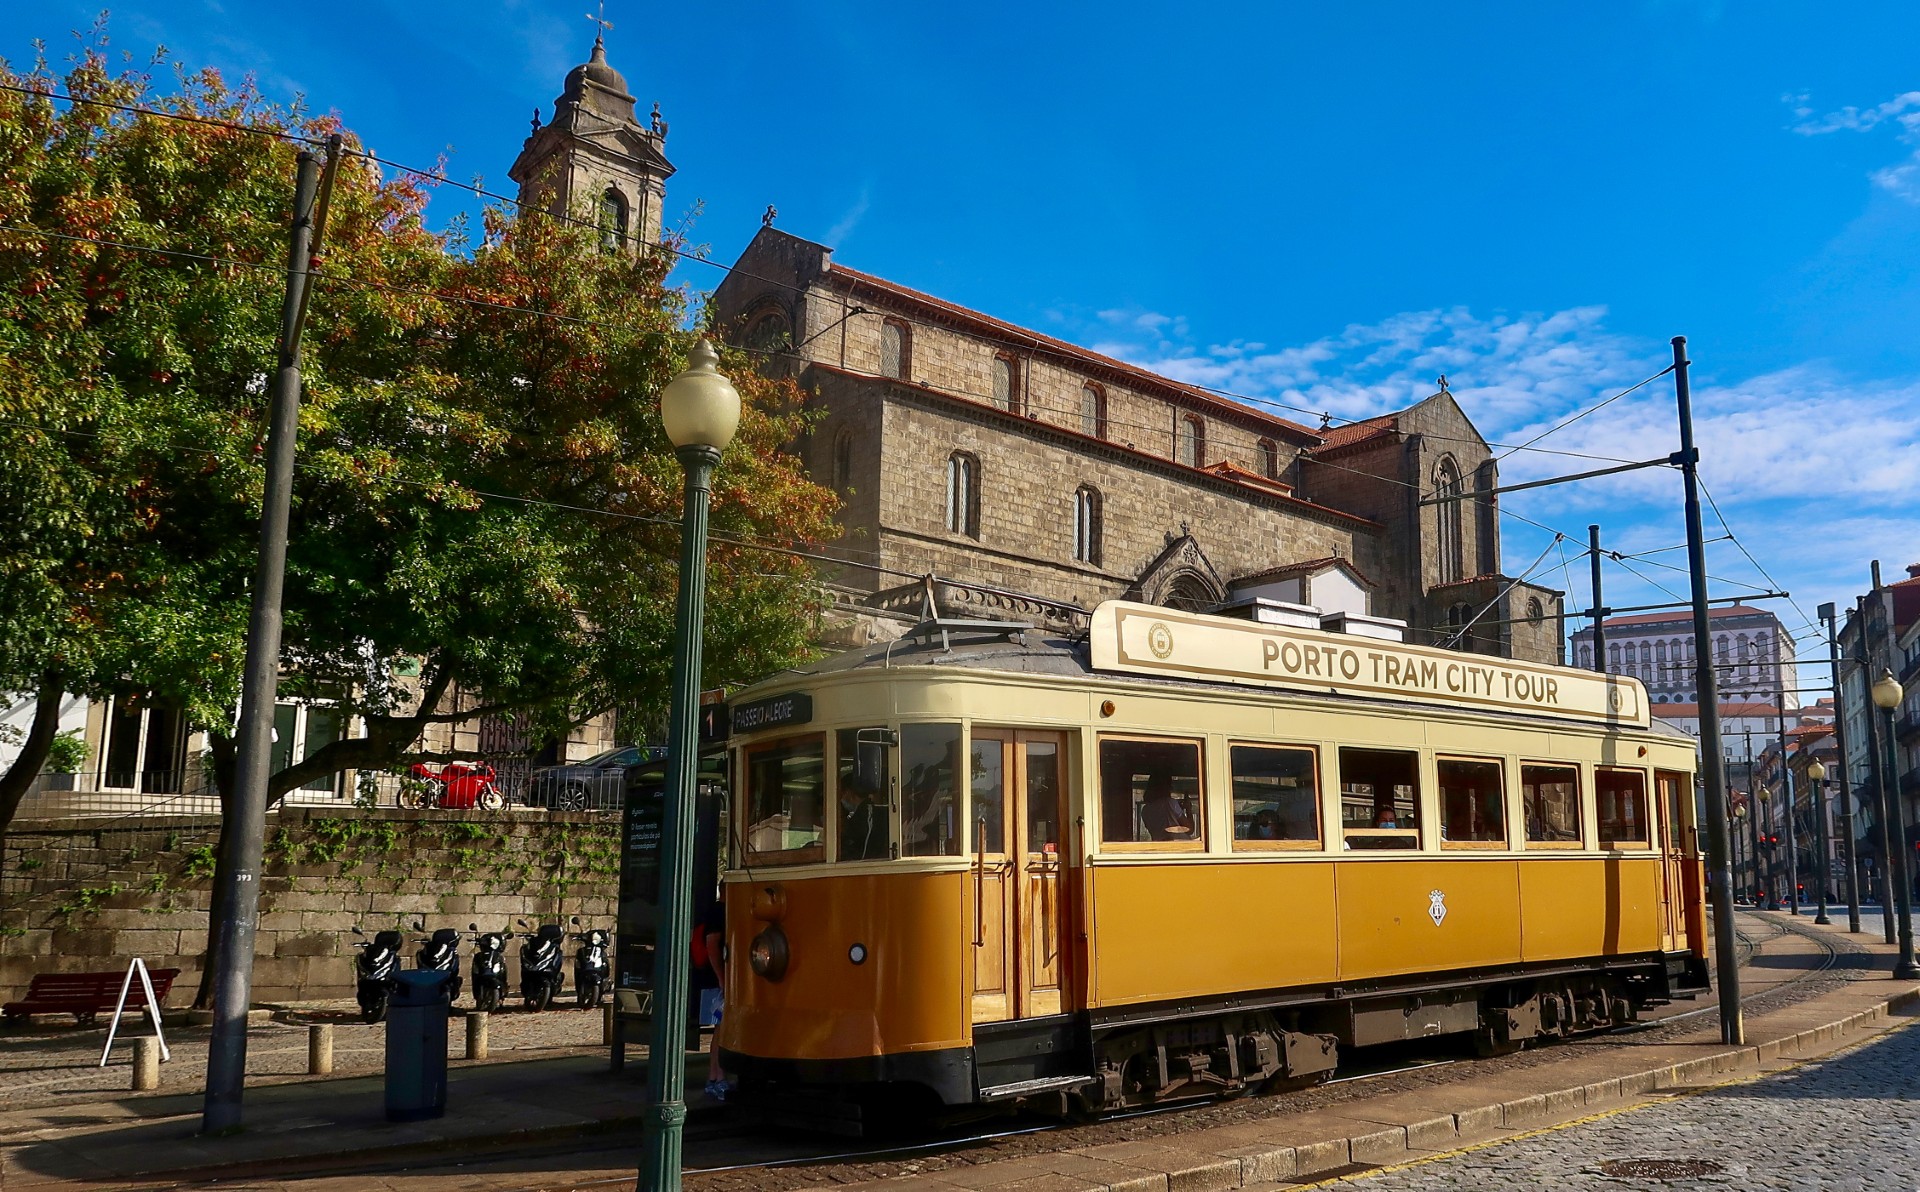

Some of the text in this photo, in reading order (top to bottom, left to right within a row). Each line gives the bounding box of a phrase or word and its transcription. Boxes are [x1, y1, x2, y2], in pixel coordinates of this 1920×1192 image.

[1262, 639, 1558, 704] PORTO TRAM CITY TOUR
[706, 709, 713, 737] 1
[735, 700, 793, 728] PASSEIO ALEGRE
